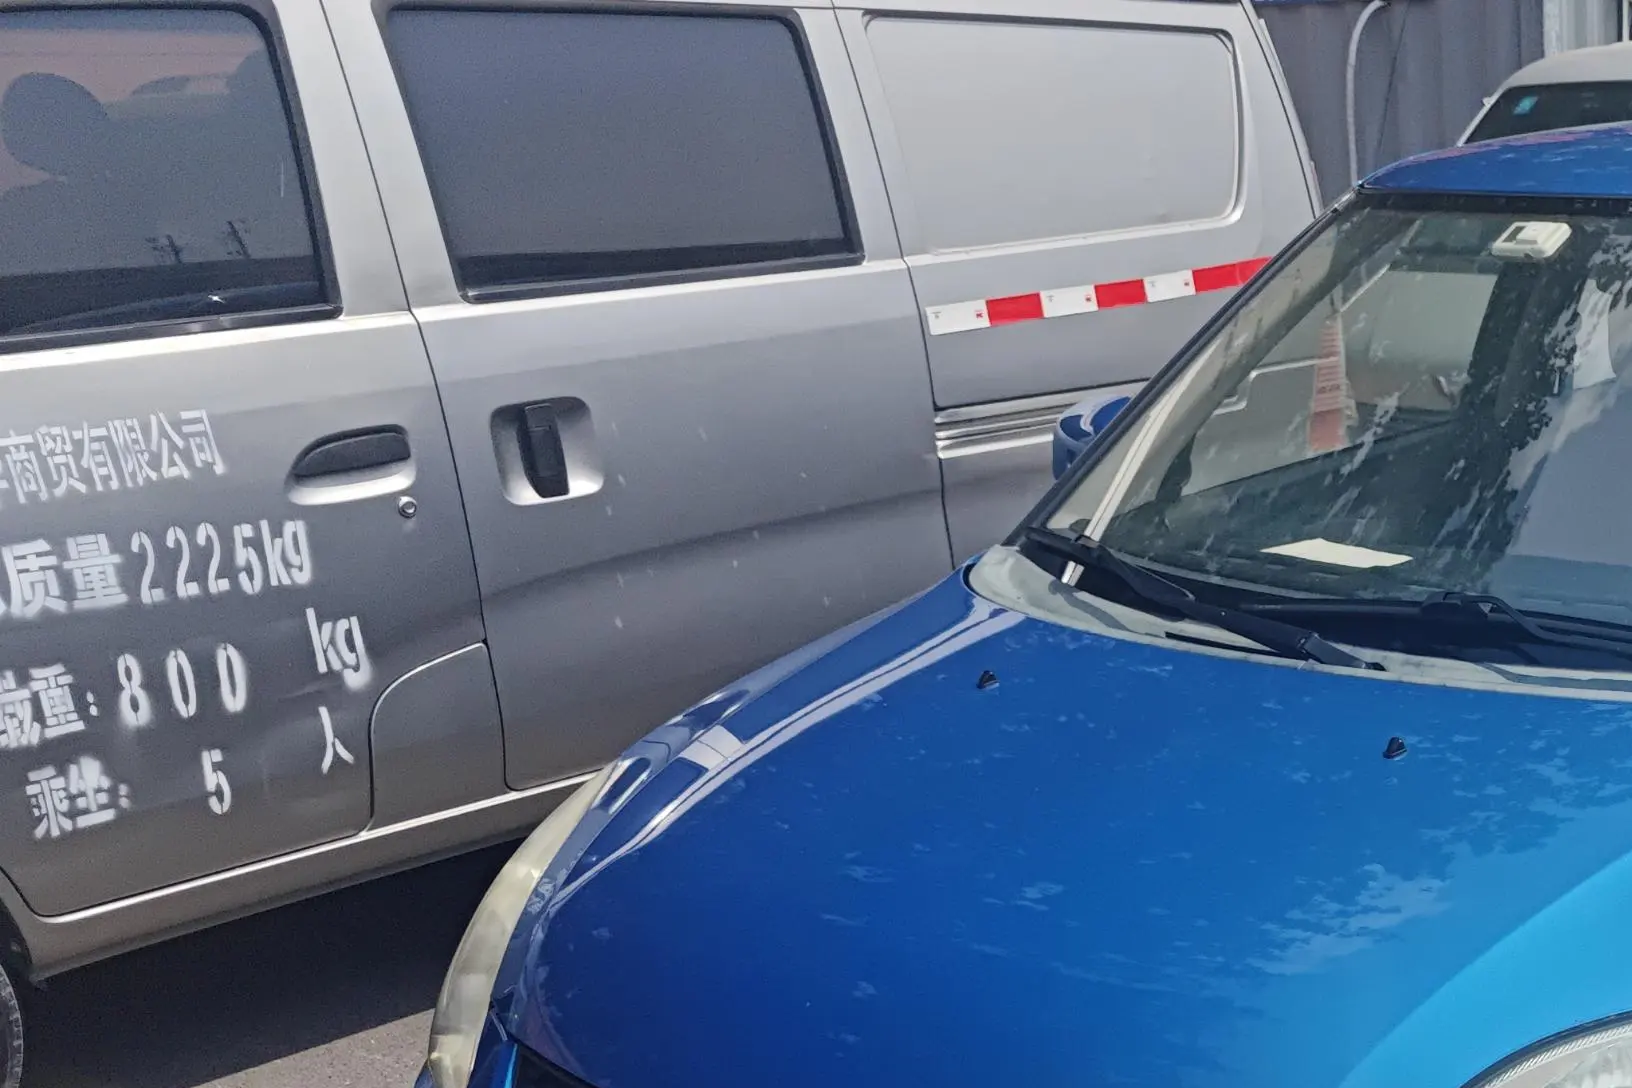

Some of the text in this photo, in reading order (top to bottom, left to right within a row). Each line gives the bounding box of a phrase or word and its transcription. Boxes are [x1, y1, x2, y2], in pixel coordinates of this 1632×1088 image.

[0, 408, 228, 503] 商贸有限公司
[0, 519, 312, 618] 质量2225kg
[201, 748, 232, 815] 5
